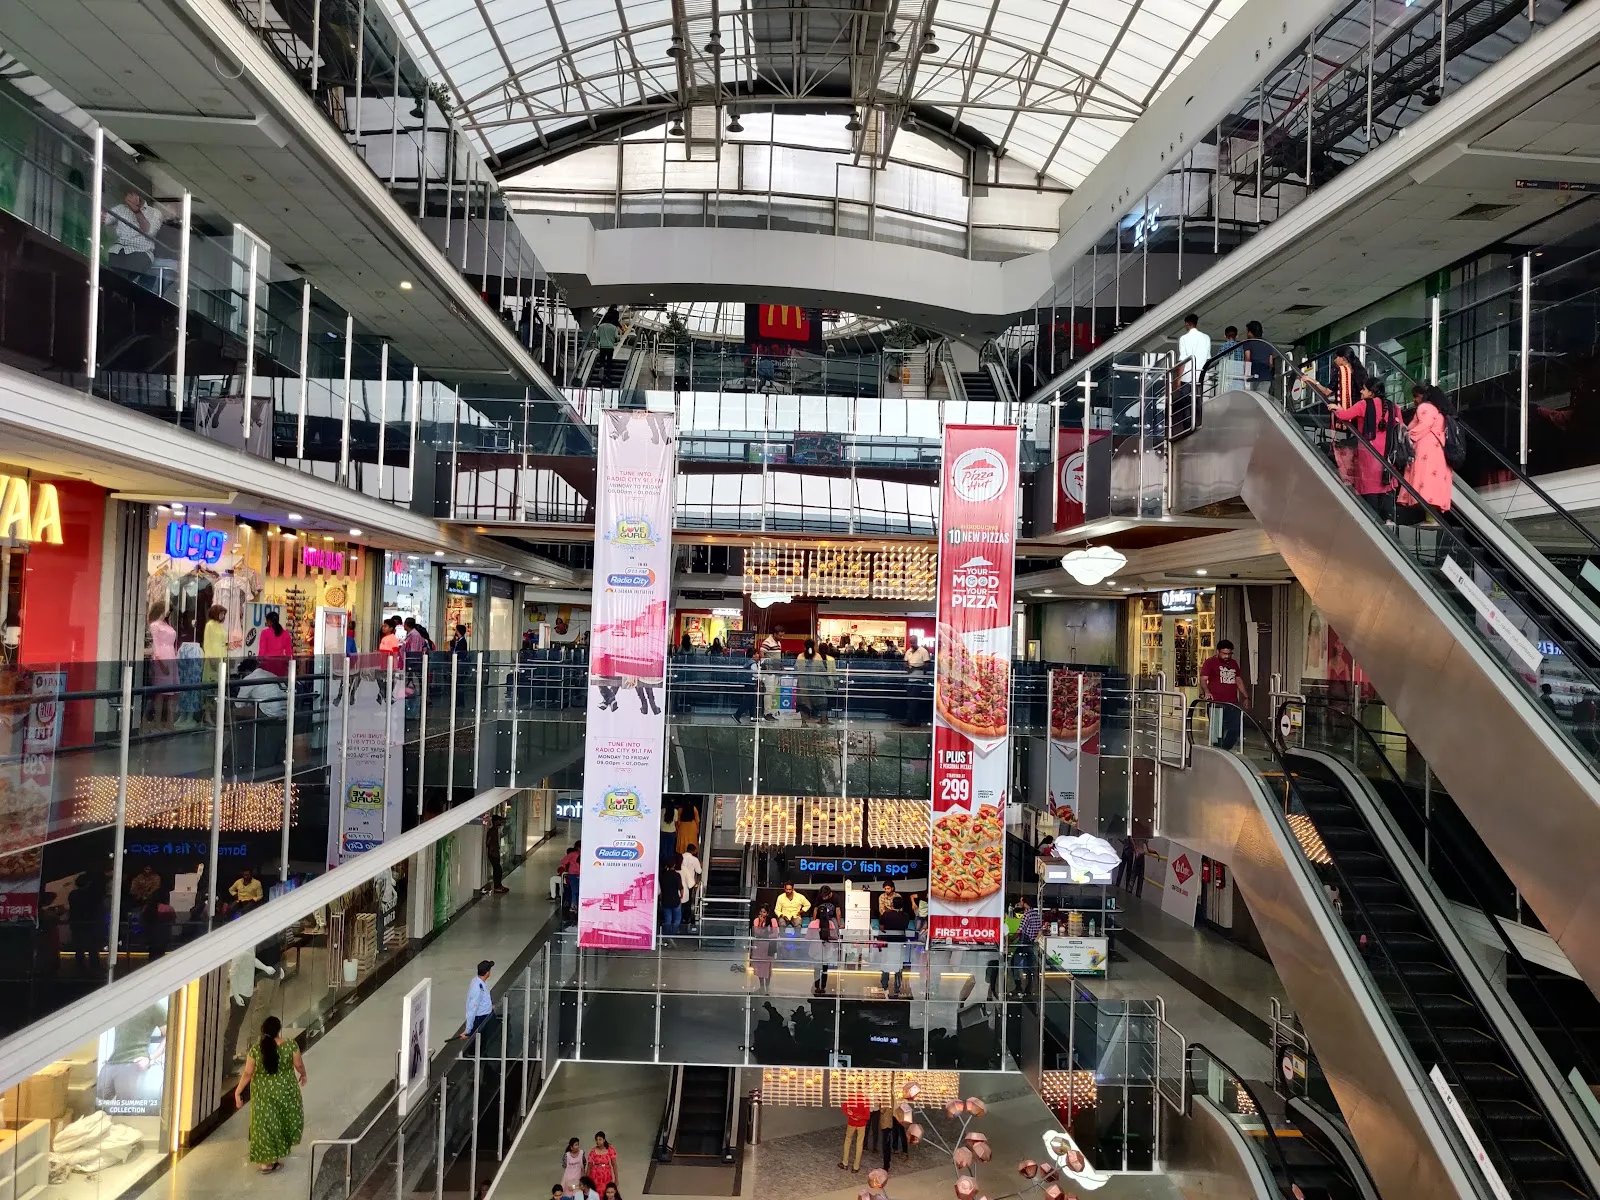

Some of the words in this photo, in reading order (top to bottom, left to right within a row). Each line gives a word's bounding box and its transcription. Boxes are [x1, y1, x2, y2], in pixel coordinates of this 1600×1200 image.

[1134, 207, 1160, 248] KFC
[962, 469, 994, 486] Pizza
[967, 480, 992, 490] Hut
[0, 475, 64, 544] AA
[948, 530, 960, 544] 10
[962, 531, 980, 542] NEW
[982, 532, 1010, 544] PIZZAS
[966, 568, 988, 576] YOUR
[610, 576, 632, 584] Radio
[632, 576, 649, 587] City
[953, 574, 1000, 589] MOOD
[966, 588, 988, 596] YOUR
[951, 595, 998, 610] PIZZA
[938, 750, 944, 764] 1
[946, 750, 966, 764] PLUS
[967, 750, 973, 764] 1
[598, 848, 620, 857] Radio
[621, 849, 638, 859] City
[800, 858, 838, 872] Barrel
[860, 860, 882, 874] fish
[885, 863, 908, 876] spa
[934, 928, 962, 937] FIRST
[963, 928, 996, 938] FLOOR
